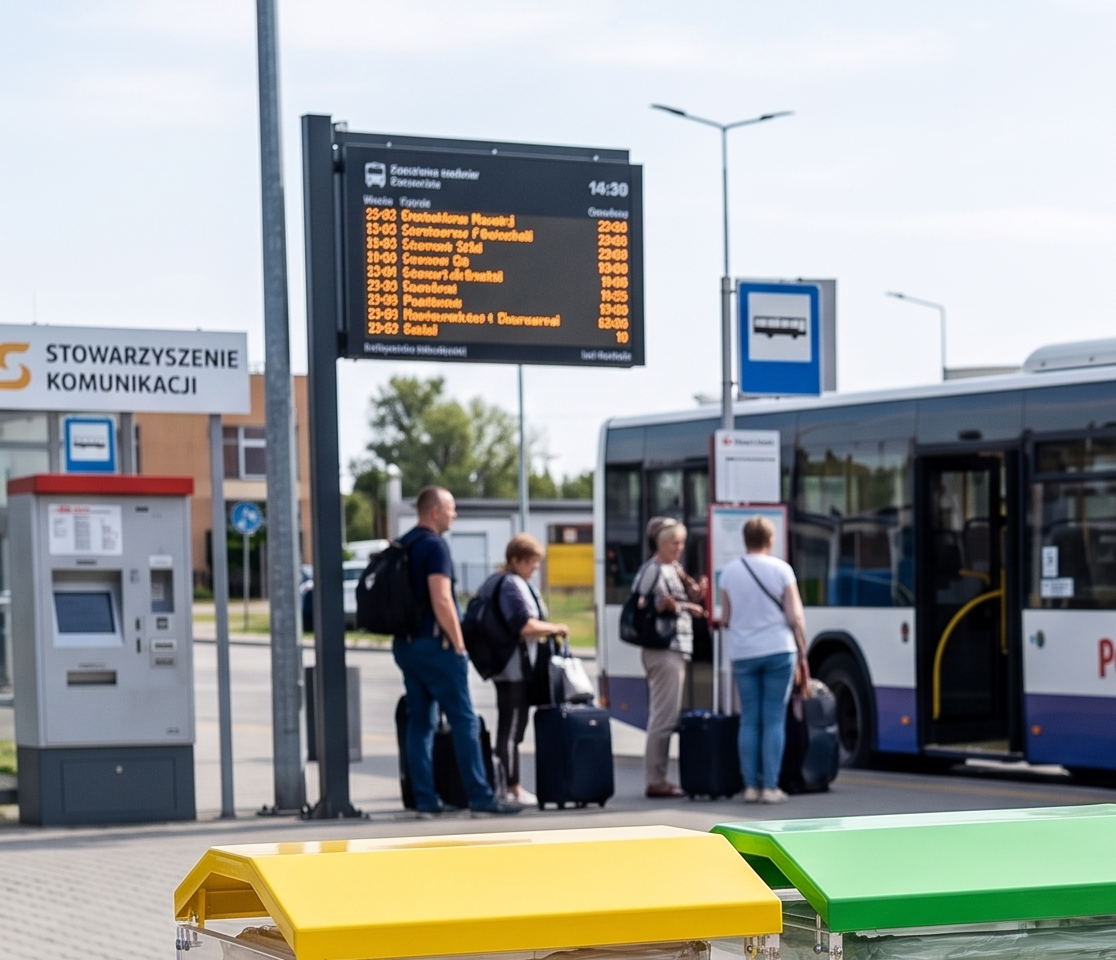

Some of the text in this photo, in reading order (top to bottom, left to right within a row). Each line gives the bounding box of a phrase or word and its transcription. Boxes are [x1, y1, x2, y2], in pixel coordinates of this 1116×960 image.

[588, 180, 629, 198] 14:30
[46, 343, 240, 369] STOWARZYSZENIE
[47, 372, 197, 395] KOMUNIKACJI
